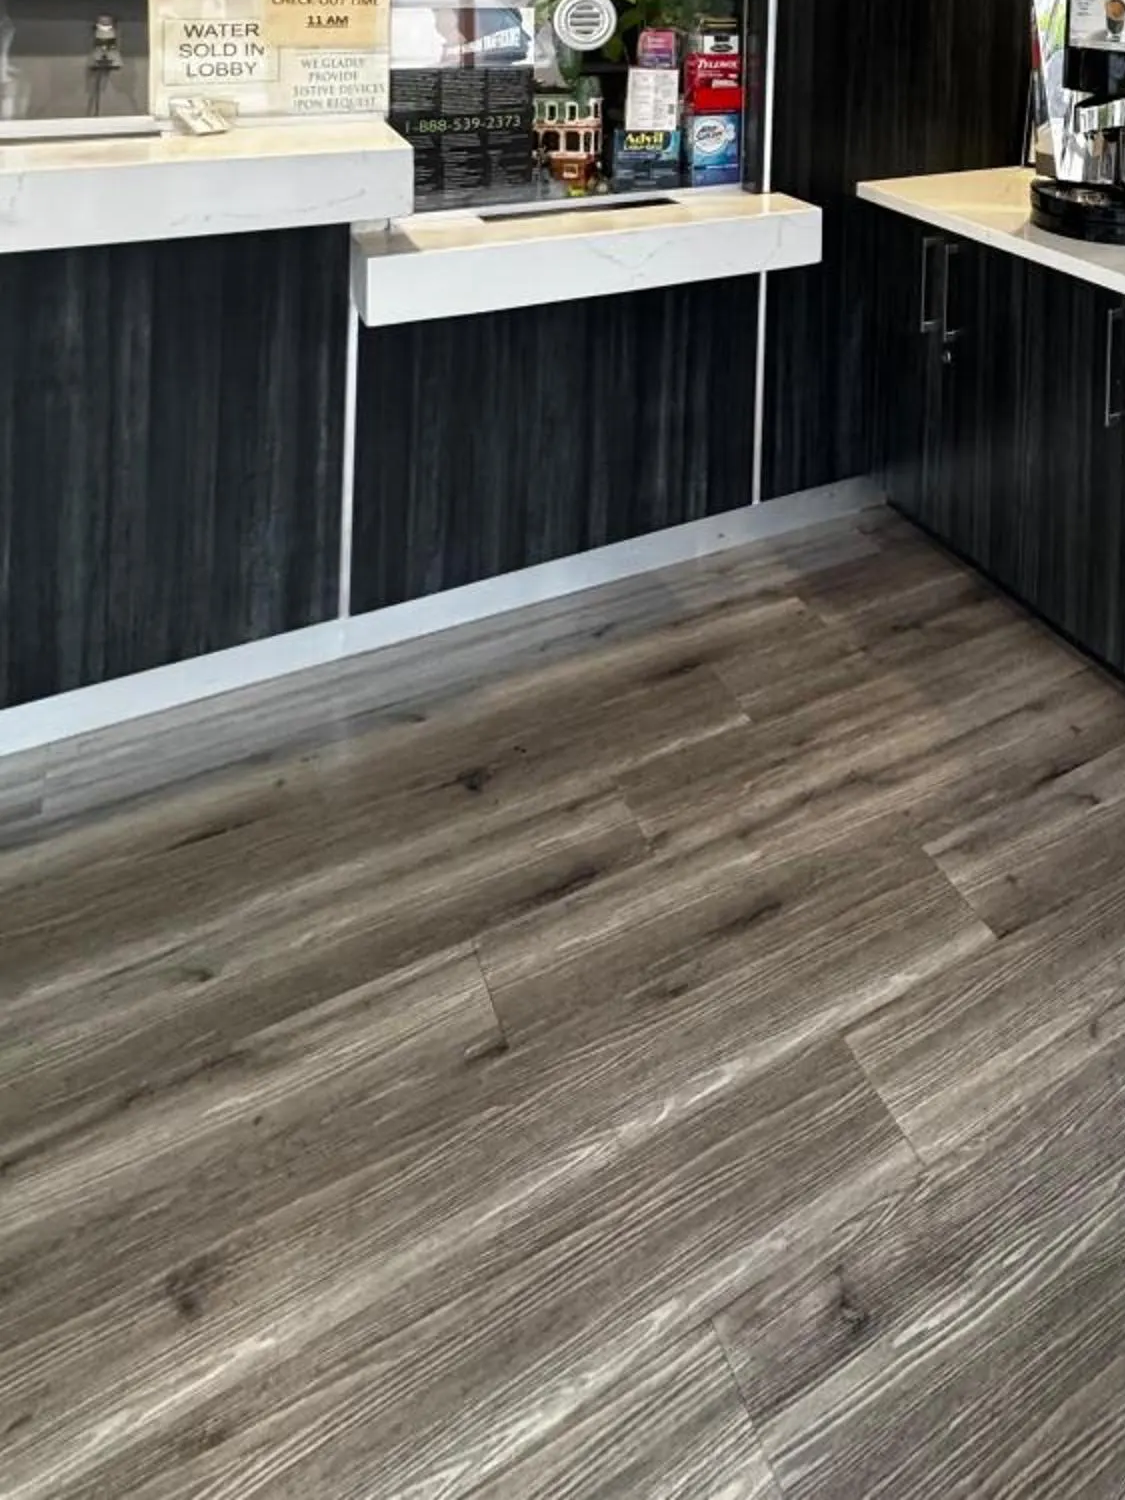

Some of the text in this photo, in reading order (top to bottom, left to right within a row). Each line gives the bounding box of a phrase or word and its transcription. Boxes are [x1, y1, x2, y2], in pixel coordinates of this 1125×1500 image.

[306, 15, 349, 28] 11 AM
[183, 23, 260, 38] WATER
[178, 43, 265, 59] SOLD IN
[185, 61, 258, 78] LOBBY
[300, 57, 319, 69] WE
[307, 70, 359, 83] PROVIDE
[626, 131, 664, 147] Advil
